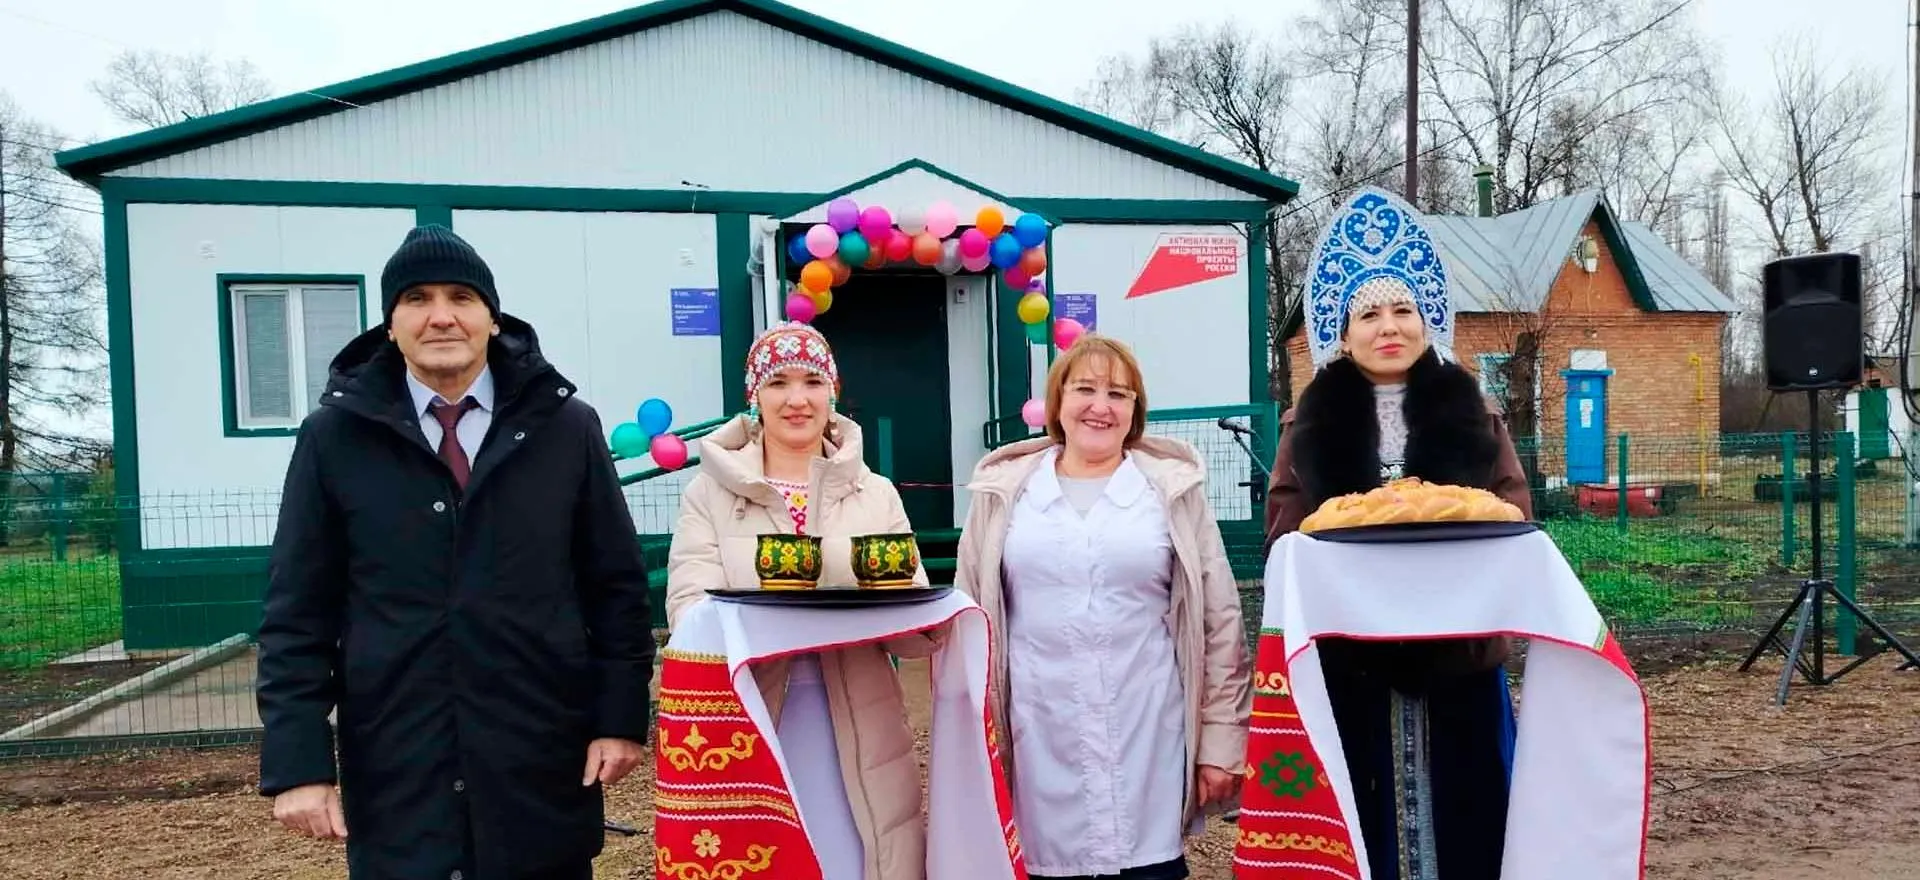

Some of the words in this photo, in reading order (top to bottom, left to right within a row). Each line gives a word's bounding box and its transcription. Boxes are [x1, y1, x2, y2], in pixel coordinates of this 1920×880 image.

[1169, 247, 1236, 255] НАЦИОНАЛЬНЫЕ
[1196, 256, 1236, 264] ПРОЕКТЫ
[1204, 264, 1236, 272] РОССИИ
